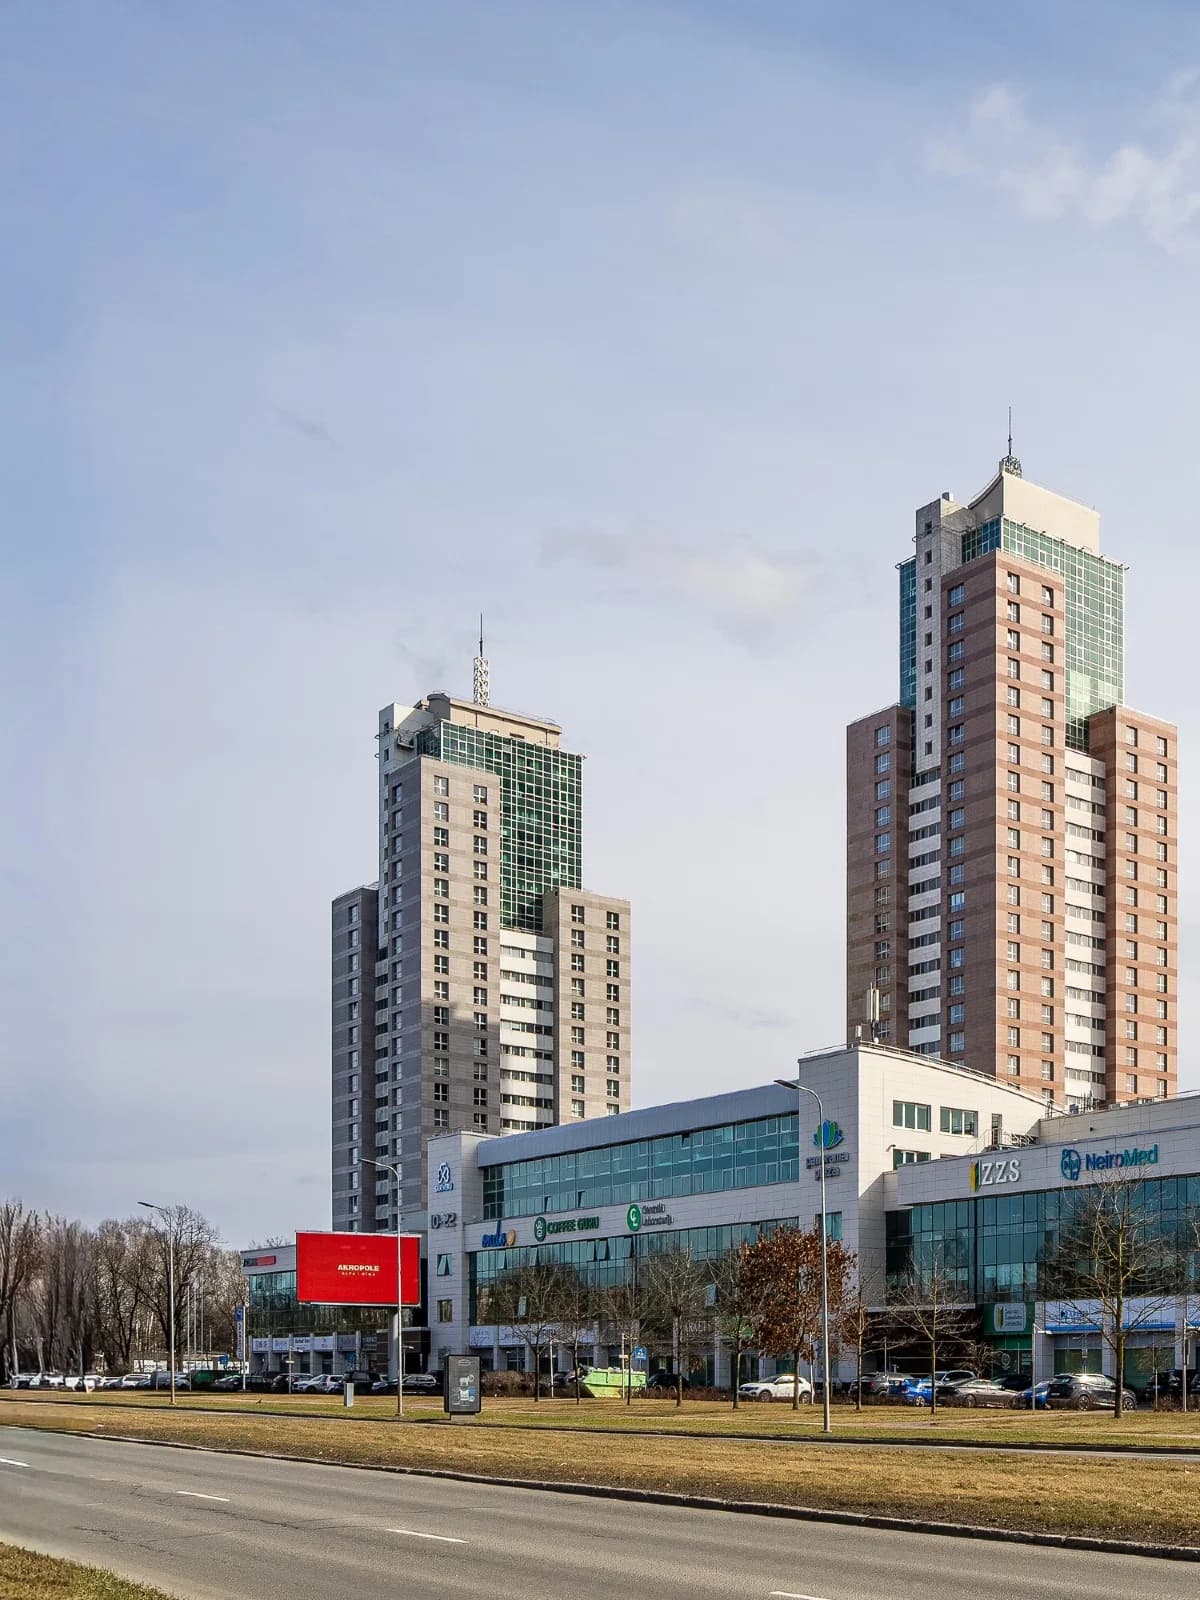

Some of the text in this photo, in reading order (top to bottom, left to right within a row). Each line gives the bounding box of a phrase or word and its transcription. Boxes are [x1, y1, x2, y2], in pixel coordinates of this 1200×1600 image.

[1085, 1143, 1159, 1171] NeiroMed
[981, 1159, 1020, 1186] ZZS
[547, 1216, 600, 1235] COFFEE GURU
[337, 1264, 380, 1272] AKROPOLE
